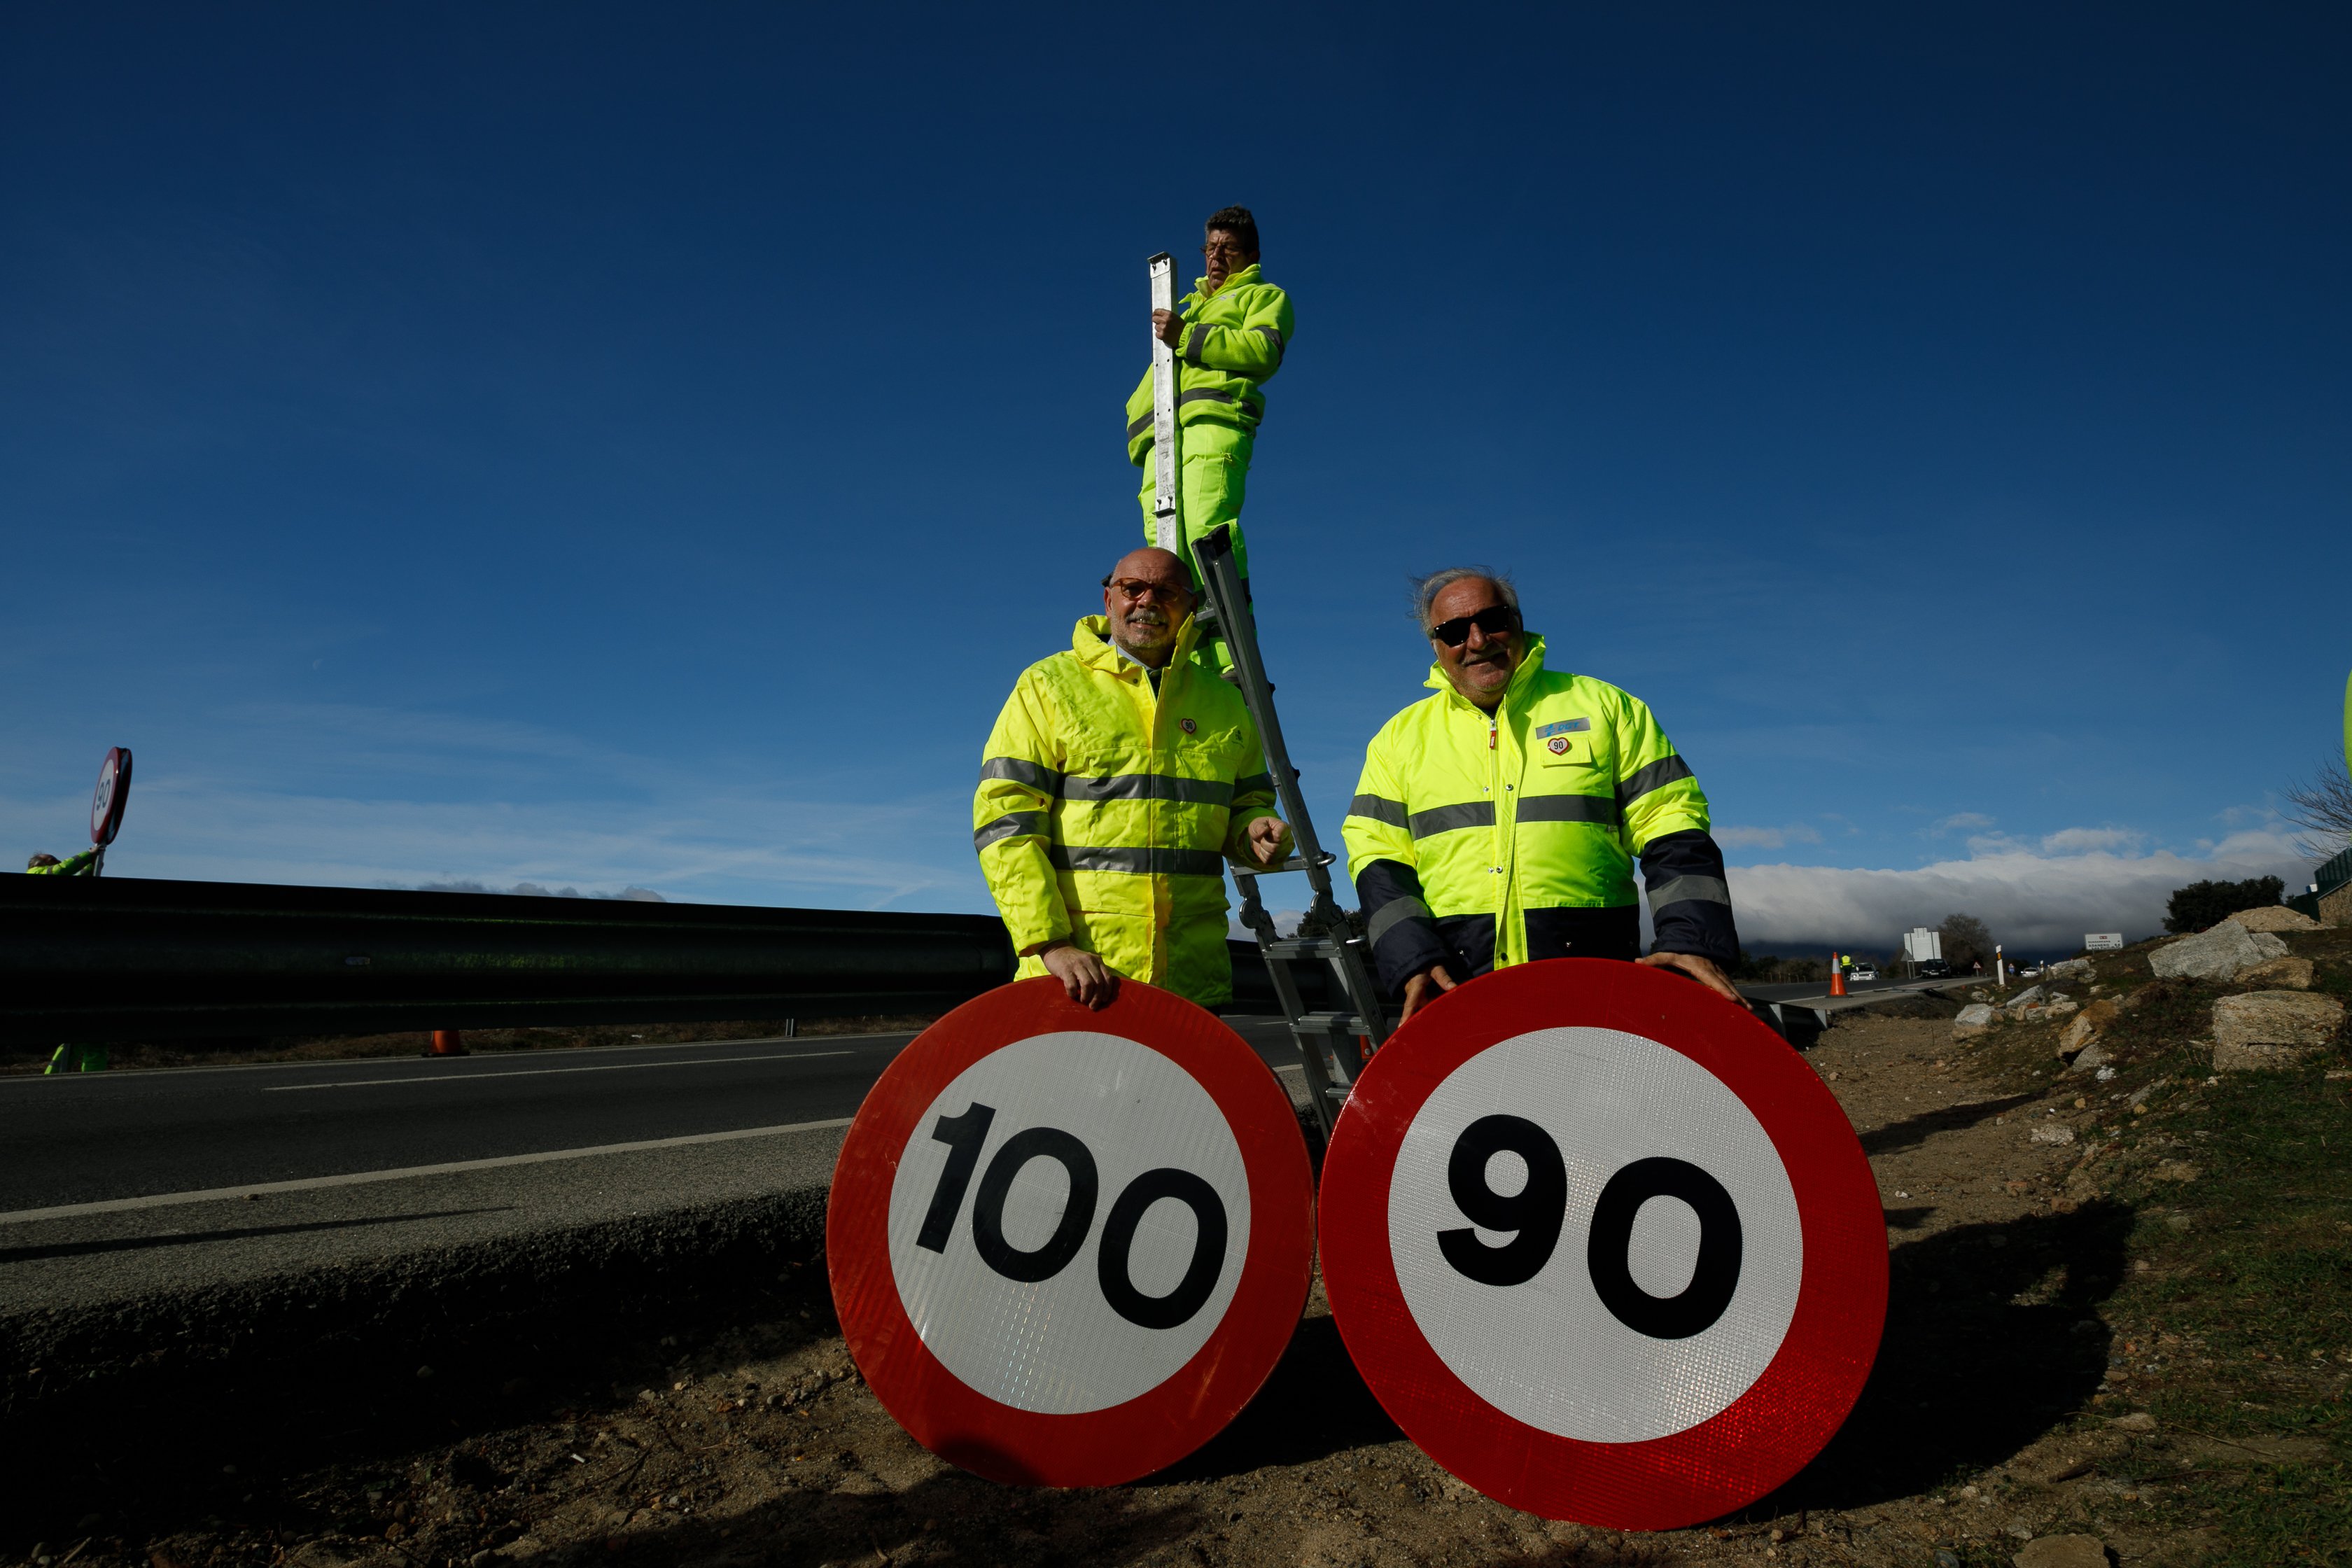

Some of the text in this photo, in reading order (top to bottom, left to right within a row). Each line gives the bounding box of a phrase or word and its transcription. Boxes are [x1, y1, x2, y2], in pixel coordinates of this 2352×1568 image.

[1558, 722, 1579, 732] DGT
[1554, 741, 1563, 750] 90
[97, 778, 111, 811] 90
[916, 1102, 1228, 1329] 100
[1436, 1114, 1742, 1340] 90
